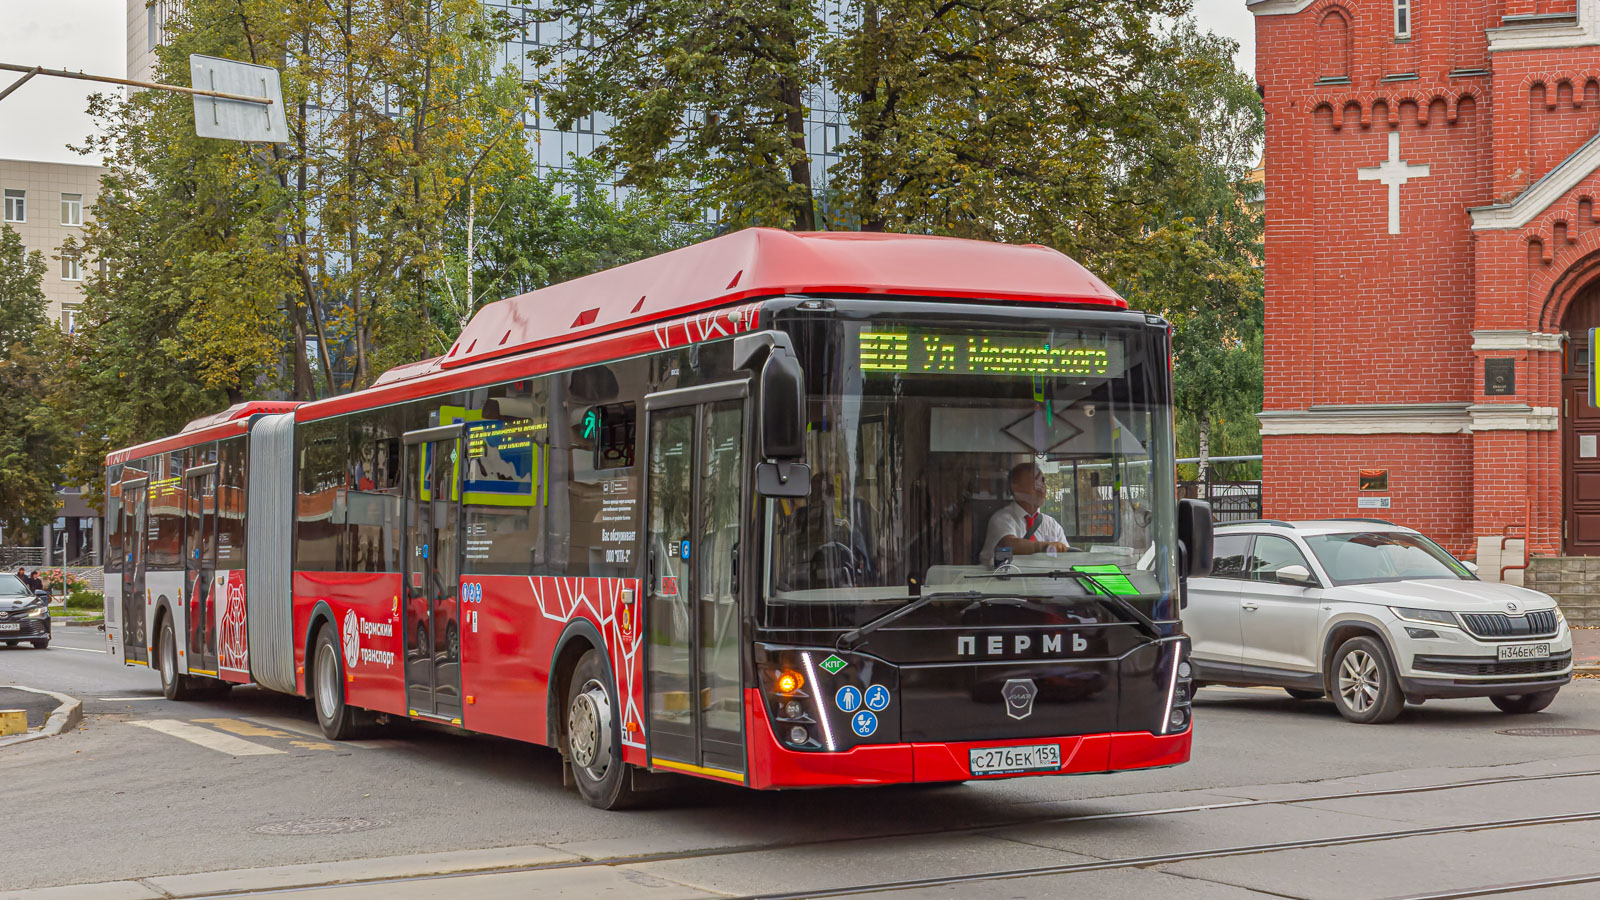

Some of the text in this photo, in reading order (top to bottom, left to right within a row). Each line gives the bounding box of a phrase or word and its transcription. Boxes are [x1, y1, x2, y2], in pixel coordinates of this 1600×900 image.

[923, 336, 955, 371] Ул
[360, 618, 392, 639] Пермский
[957, 632, 1088, 655] ПЕРМЬ
[361, 649, 394, 669] транспорт
[825, 660, 841, 668] КПГ
[1035, 747, 1056, 760] 159
